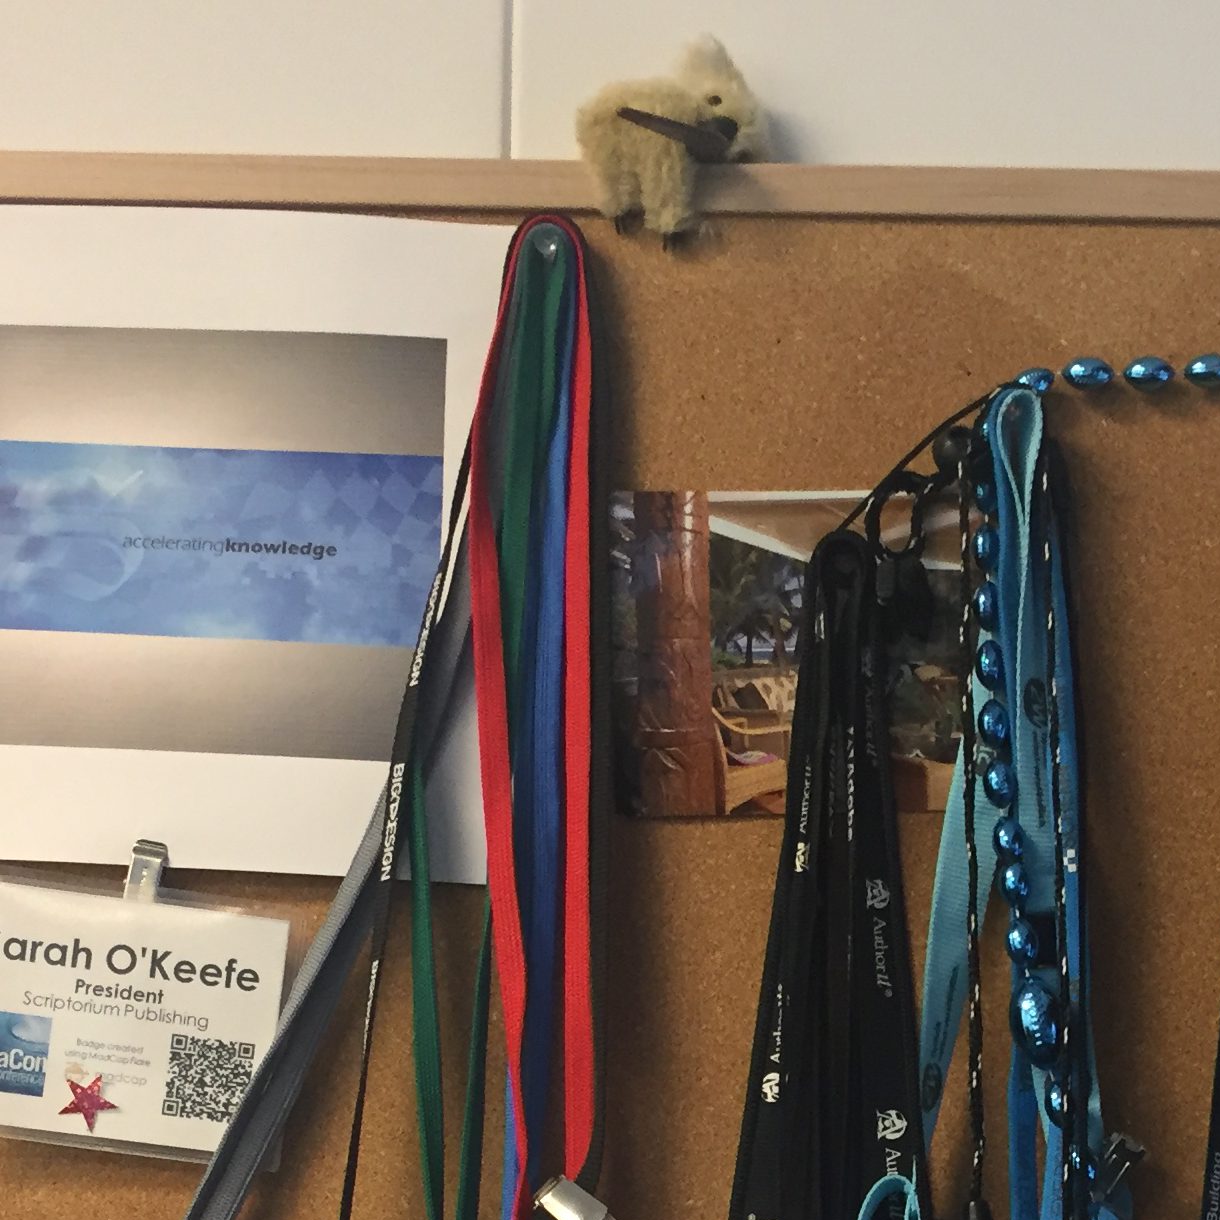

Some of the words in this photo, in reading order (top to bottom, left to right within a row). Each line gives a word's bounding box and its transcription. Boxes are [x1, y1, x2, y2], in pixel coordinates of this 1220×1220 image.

[122, 534, 338, 559] acceleratingknowledge
[0, 932, 92, 970] arah
[106, 944, 260, 992] O'Keefe
[74, 979, 164, 1004] President
[22, 991, 120, 1016] Scriptorium
[124, 1004, 209, 1031] Publishing
